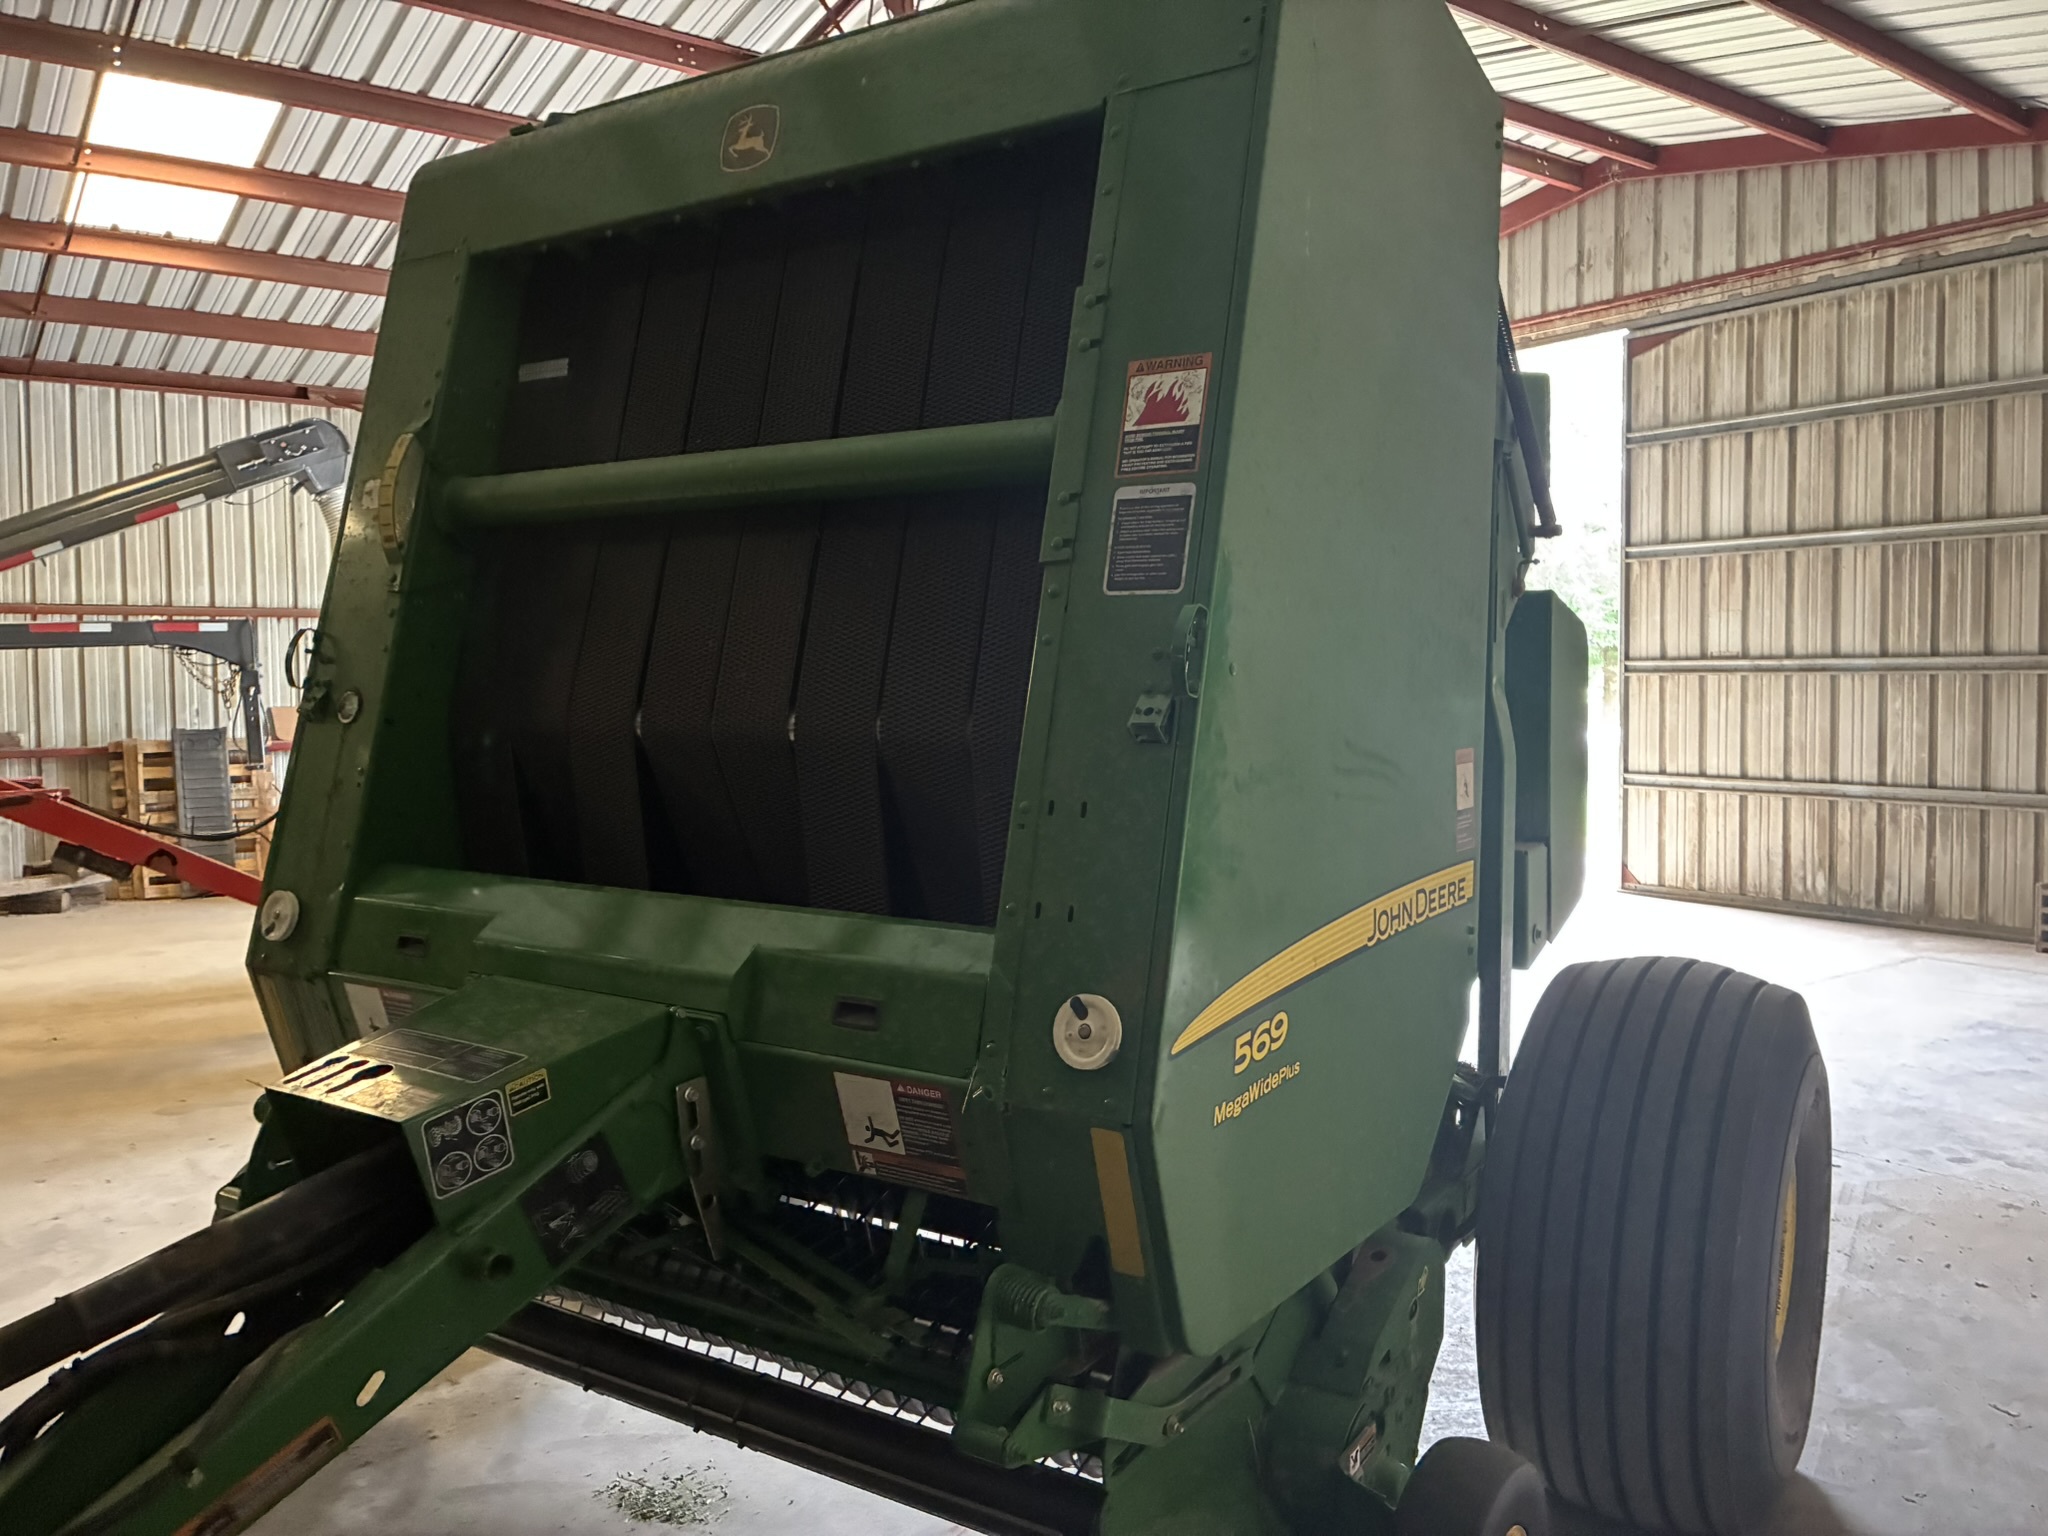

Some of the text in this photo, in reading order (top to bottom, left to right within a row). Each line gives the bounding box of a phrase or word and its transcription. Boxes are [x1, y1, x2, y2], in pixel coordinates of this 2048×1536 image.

[1147, 355, 1204, 371] WARNING
[1367, 877, 1467, 943] JOHN DEERE
[1233, 1010, 1289, 1075] 569
[906, 1085, 942, 1098] DANGER
[1213, 1061, 1301, 1127] MegaWidePlus
